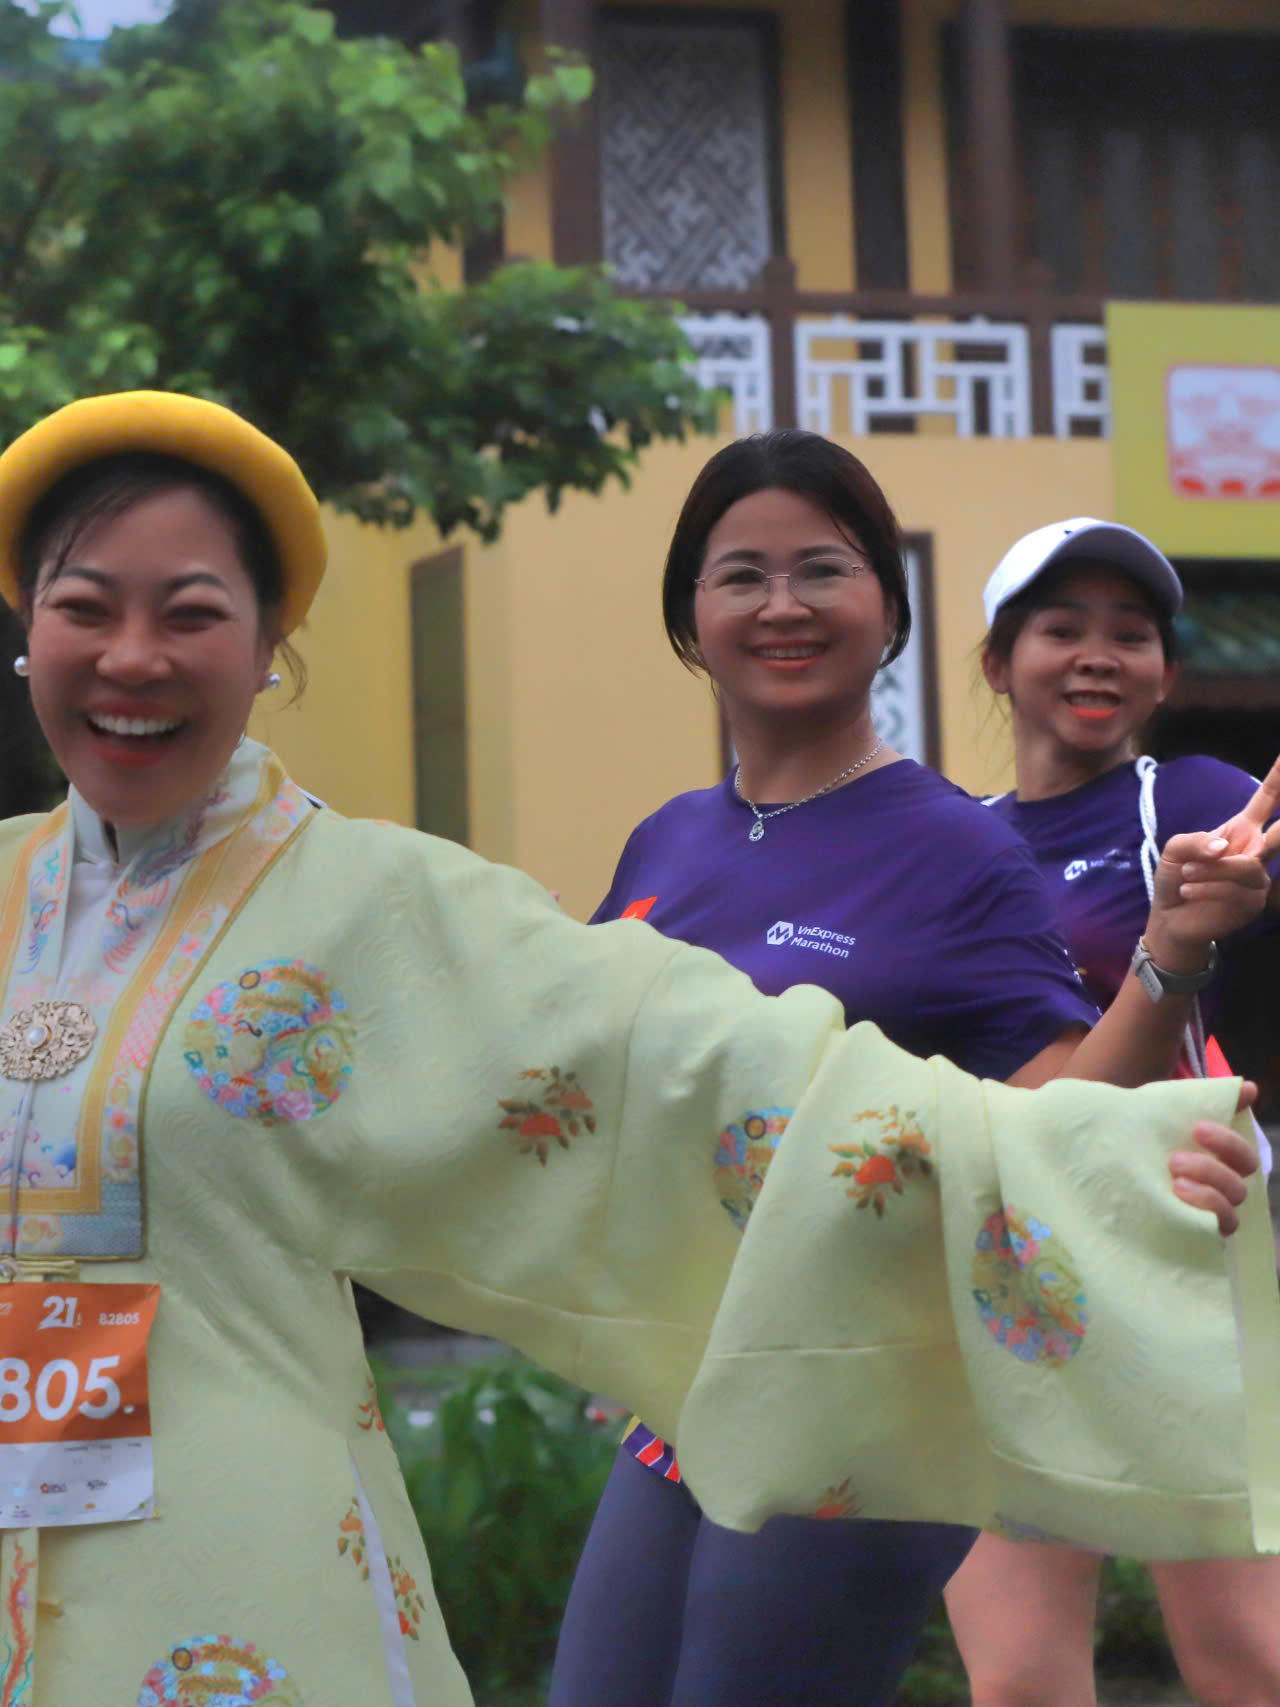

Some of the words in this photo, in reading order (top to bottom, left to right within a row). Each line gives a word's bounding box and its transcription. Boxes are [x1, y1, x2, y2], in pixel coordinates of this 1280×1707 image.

[798, 925, 856, 945] VnExpress
[790, 937, 850, 958] Marathon
[38, 1295, 78, 1330] 21
[99, 1312, 140, 1326] 82805
